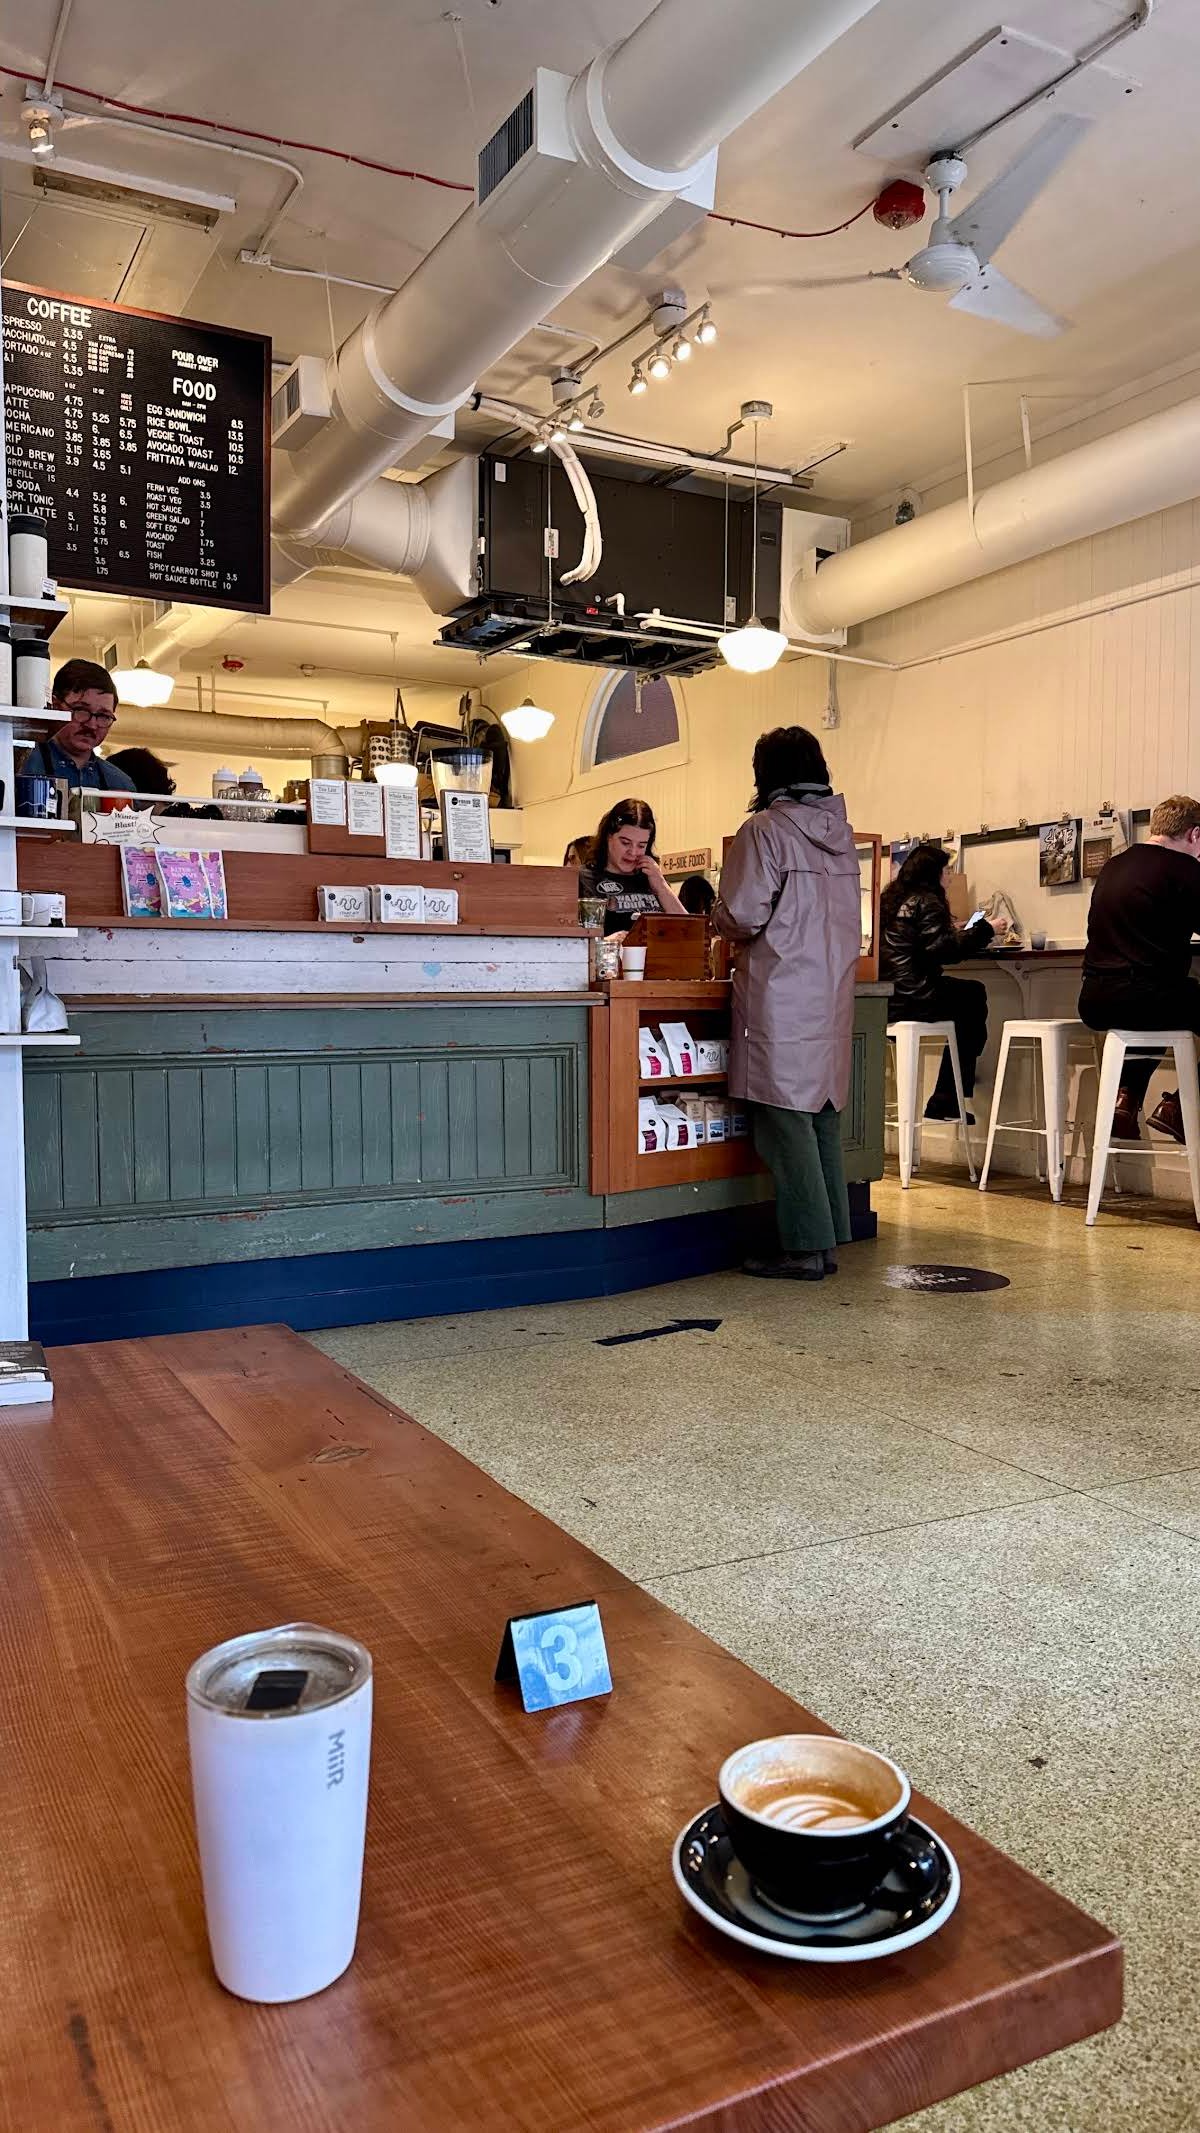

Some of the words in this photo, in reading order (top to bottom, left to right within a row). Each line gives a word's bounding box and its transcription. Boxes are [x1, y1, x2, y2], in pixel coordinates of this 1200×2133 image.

[26, 297, 92, 328] COFFEE
[2, 314, 42, 332] SPRESSO
[63, 328, 83, 340] 3.35
[62, 340, 77, 352] 4.5
[98, 334, 116, 344] EXTRA
[62, 352, 77, 364] 4.5
[172, 350, 195, 363] POUR
[196, 355, 219, 368] OVER
[177, 360, 197, 370] MARKET
[64, 364, 84, 377] 5.35
[4, 383, 54, 401] APPUCCINO
[64, 394, 84, 407] 4.75
[172, 377, 217, 401] FOOD
[5, 396, 30, 410] ATTE
[64, 407, 83, 419] 4.75
[92, 412, 110, 424] 5.25
[120, 417, 137, 429] 5.75
[146, 404, 163, 416] EGG
[165, 407, 207, 423] SANDWICH
[231, 419, 244, 430] 8.5
[4, 408, 31, 422] OCHA
[64, 419, 78, 430] 5.5
[119, 429, 133, 440] 6.5
[146, 416, 166, 428] RICE
[168, 420, 191, 432] BOWL
[228, 430, 244, 441] 13.5
[5, 420, 54, 438] MERICANO
[65, 431, 83, 443] 3.85
[92, 436, 110, 448] 3.85
[119, 441, 137, 453] 3.85
[146, 428, 175, 442] VEGGIE
[178, 433, 204, 446] TOAST
[229, 442, 244, 453] 10.5
[5, 432, 22, 444] RIP
[66, 444, 82, 455] 3.15
[92, 448, 112, 460] 3.65
[146, 440, 184, 454] AVOCADO
[186, 446, 214, 460] TOAST
[228, 454, 244, 464] 10.5
[6, 445, 24, 457] OLD
[28, 449, 54, 462] BREW
[66, 455, 79, 466] 3.9
[92, 460, 106, 471] 4.5
[120, 464, 131, 475] 5.1
[7, 458, 44, 471] GROWLER
[46, 464, 56, 472] 20
[146, 452, 185, 466] FRITTATA
[188, 460, 218, 472] W/SALAD
[8, 467, 34, 480] REFILL
[48, 474, 55, 482] 15
[178, 476, 190, 485] ADD
[192, 479, 206, 488] ONS
[16, 480, 41, 492] SODA
[66, 488, 79, 498] 4.4
[92, 492, 107, 502] 5.2
[120, 496, 128, 506] 6.
[146, 482, 165, 492] FERM
[166, 486, 179, 494] VEG
[200, 491, 211, 500] 3.5
[28, 492, 54, 506] TONIC
[92, 504, 107, 514] 5.8
[146, 493, 167, 503] ROAST
[169, 496, 182, 505] VEG
[200, 501, 211, 509] 3.5
[146, 502, 159, 511] HOT
[161, 505, 182, 514] SAUCE
[7, 502, 22, 513] HAI
[27, 505, 58, 519] LATTE
[93, 516, 107, 526] 5.5
[120, 520, 128, 529] 6.
[146, 512, 167, 522] GREEN
[170, 515, 190, 525] SALAD
[67, 523, 79, 532] 3.1
[146, 522, 162, 531] SOFT
[165, 524, 178, 532] EGG
[146, 531, 174, 542] AVOCADO
[200, 539, 214, 548] 1.75
[146, 540, 166, 550] TOAST
[66, 542, 78, 552] 3.5
[94, 547, 99, 555] 5
[119, 550, 130, 559] 6.5
[146, 550, 162, 560] FISH
[200, 558, 216, 566] 3.25
[95, 557, 106, 565] 3.5
[149, 563, 170, 572] SPICY
[170, 565, 198, 576] CARROT
[201, 569, 219, 578] SHOT
[226, 573, 238, 581] 3.5
[164, 574, 187, 584] SAUCE
[190, 578, 217, 588] BOTTLE
[689, 853, 705, 867] FOODS
[618, 901, 645, 909] TOUR
[540, 1624, 584, 1691] 3
